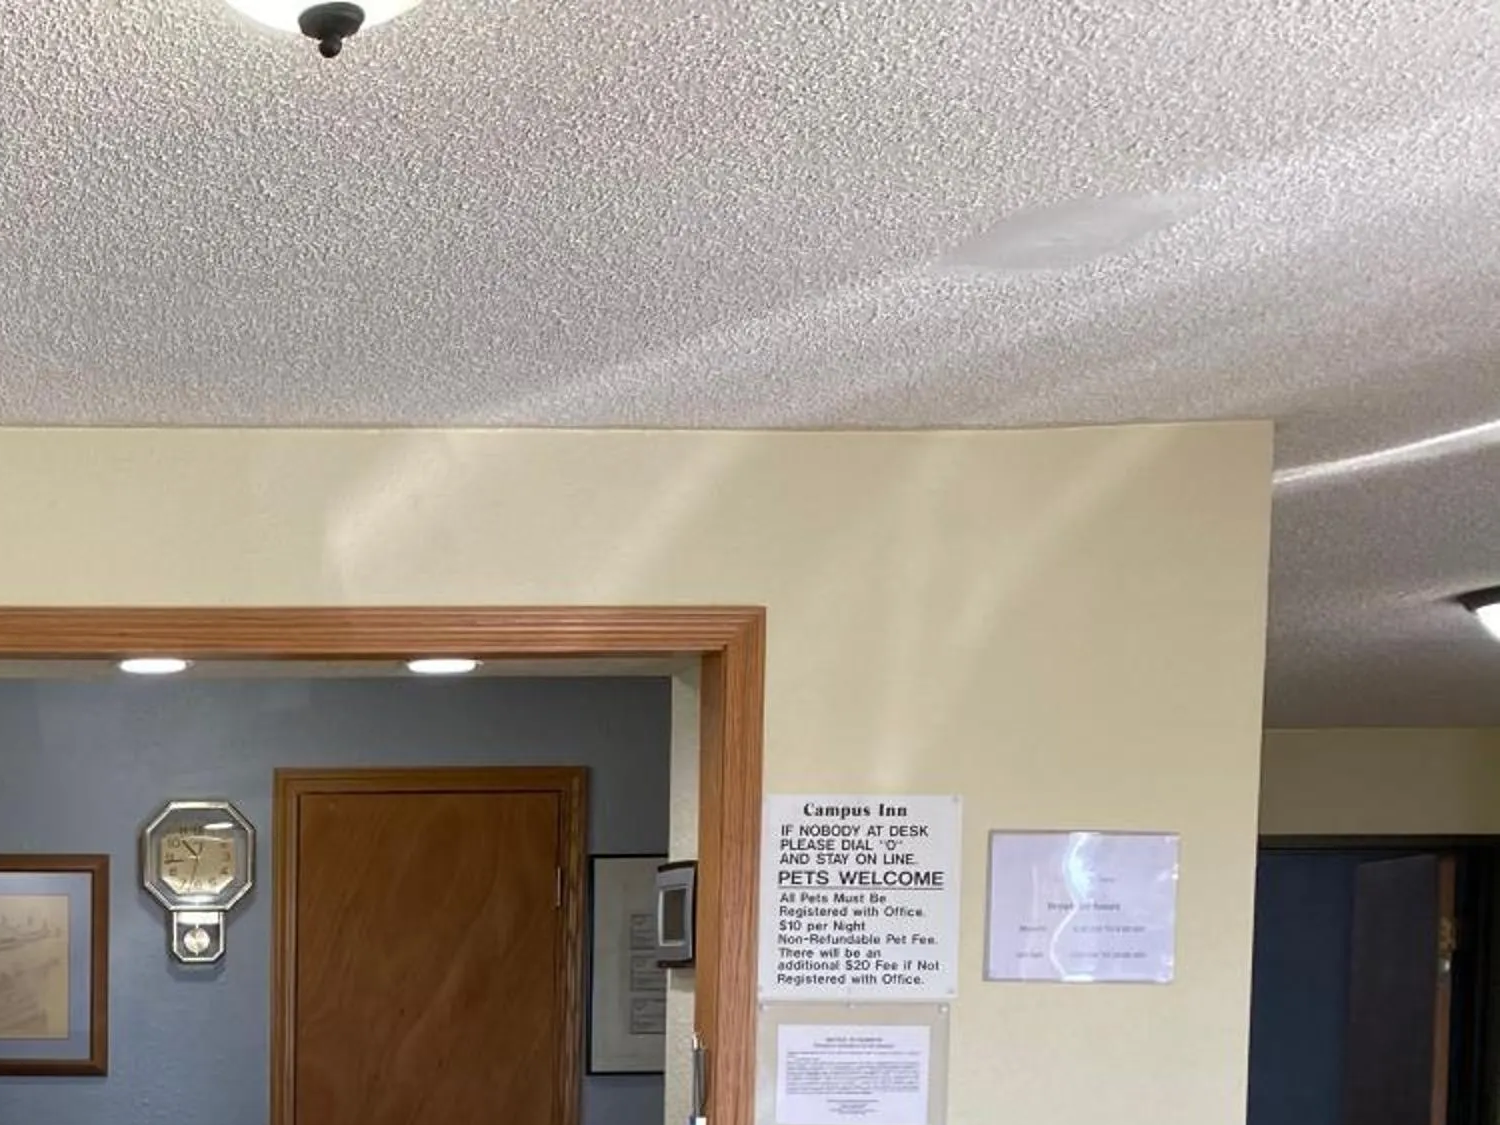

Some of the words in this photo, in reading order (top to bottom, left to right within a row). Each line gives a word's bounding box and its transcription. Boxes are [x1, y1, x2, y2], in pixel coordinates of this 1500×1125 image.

[803, 803, 871, 820] Campus
[878, 803, 908, 817] Inn
[780, 825, 794, 837] IF
[799, 825, 861, 837] NOBODY
[867, 825, 884, 837] AT
[889, 825, 929, 837] DESK
[779, 839, 835, 851] PLEASE
[841, 839, 873, 851] DIAL
[779, 853, 810, 865] AND
[815, 853, 849, 865] STAY
[855, 853, 877, 865] ON
[777, 870, 829, 885] PETS
[838, 871, 945, 886] WELCOME
[779, 893, 797, 903] All
[800, 893, 829, 903] Pets
[833, 893, 865, 904] Must
[869, 893, 887, 904] Be
[778, 906, 848, 919] Registered
[853, 906, 879, 917] with
[778, 920, 802, 931] $10
[807, 922, 828, 933] per
[833, 920, 866, 933] Night
[777, 934, 881, 945] Non-Refundable
[885, 934, 907, 945] Pet
[911, 934, 939, 945] Fee.
[778, 948, 815, 958] There
[819, 948, 839, 958] will
[844, 948, 861, 958] be
[866, 949, 882, 958] an
[844, 960, 871, 971] $20
[875, 960, 899, 971] Fee
[903, 960, 913, 971] if
[917, 960, 940, 971] Not
[777, 974, 846, 987] Registered
[851, 974, 877, 985] with
